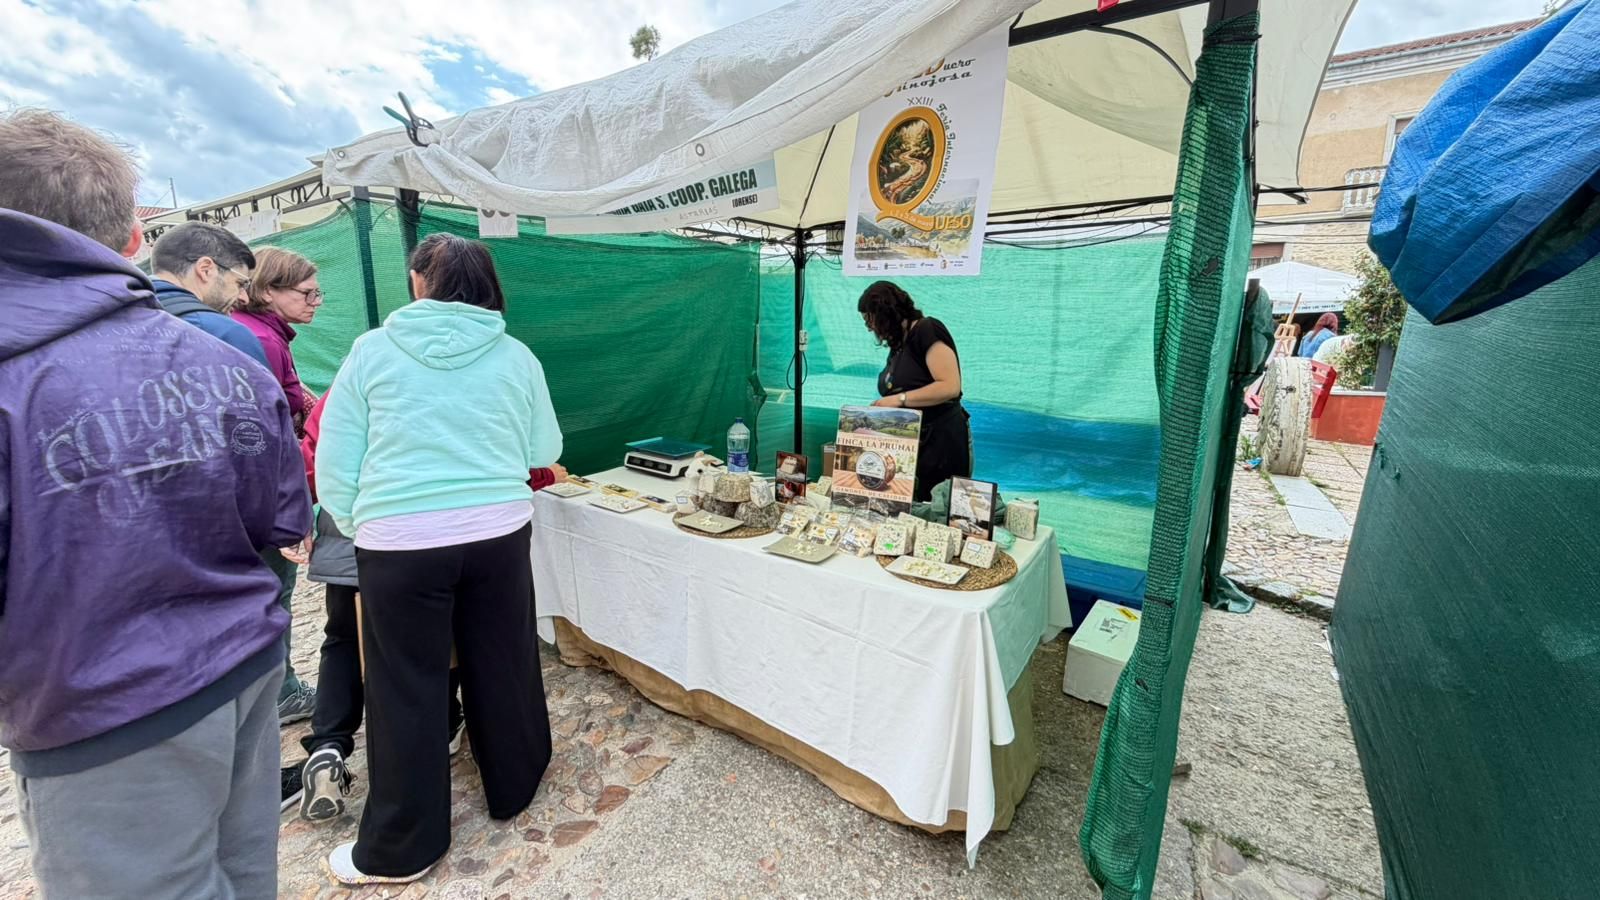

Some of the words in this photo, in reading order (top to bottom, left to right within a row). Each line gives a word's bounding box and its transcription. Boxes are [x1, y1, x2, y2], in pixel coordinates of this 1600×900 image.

[907, 96, 934, 107] XXIII
[936, 103, 952, 131] Feria
[667, 182, 709, 207] COOP.
[708, 168, 758, 198] GALEGA
[45, 364, 256, 492] COLOSSUS
[837, 437, 864, 447] FINCA
[866, 440, 877, 449] LA
